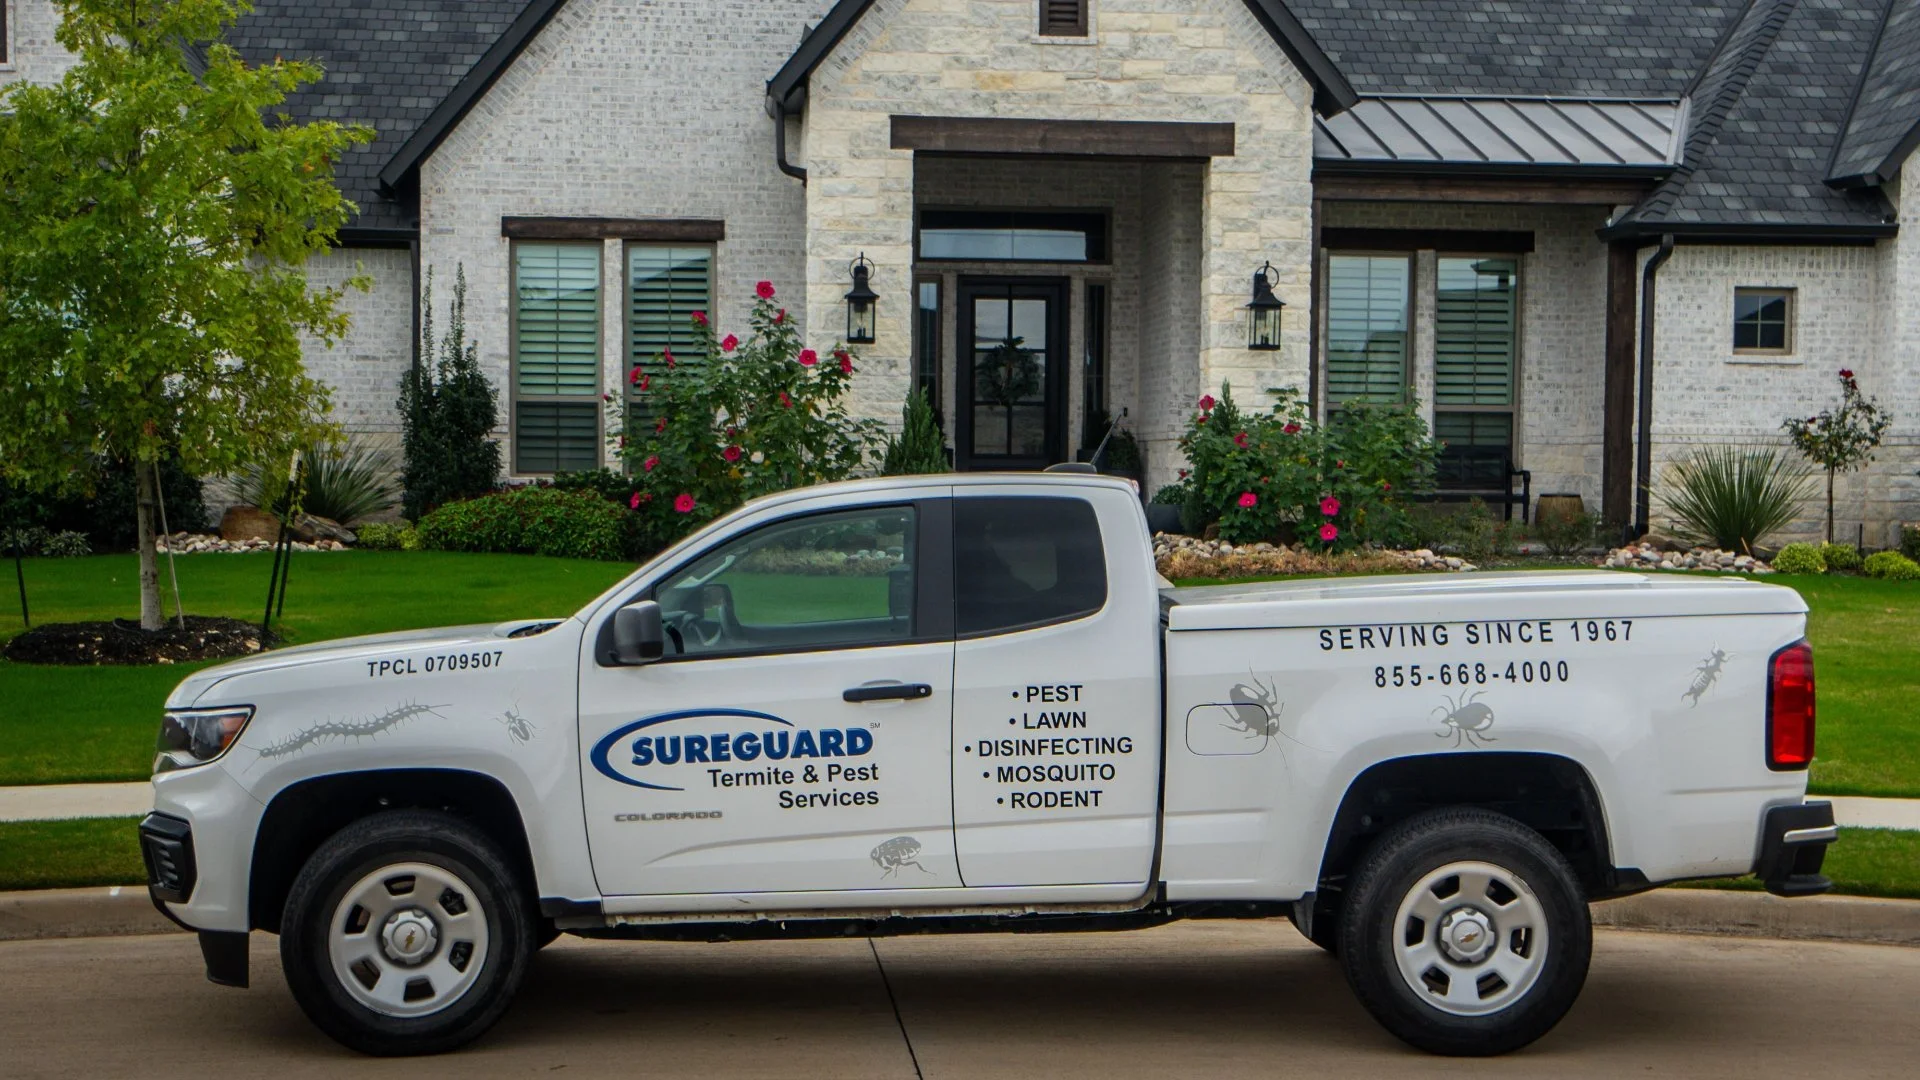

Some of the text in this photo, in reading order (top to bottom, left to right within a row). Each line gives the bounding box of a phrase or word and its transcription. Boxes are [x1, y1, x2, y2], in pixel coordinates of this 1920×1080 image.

[1319, 620, 1633, 651] SERVING SINCE 1967
[367, 650, 503, 678] TPCL 0709507
[1374, 660, 1569, 688] 855-668-4000
[1026, 684, 1083, 703] PEST
[1023, 711, 1087, 730] LAWN
[631, 727, 873, 766] SUREGUARD
[978, 737, 1133, 757] DISINFECTING
[707, 762, 880, 788] Termite & Pest
[996, 763, 1116, 784] MOSQUITO
[778, 788, 880, 809] Services
[1010, 790, 1103, 809] RODENT
[613, 810, 723, 823] COLORADO
